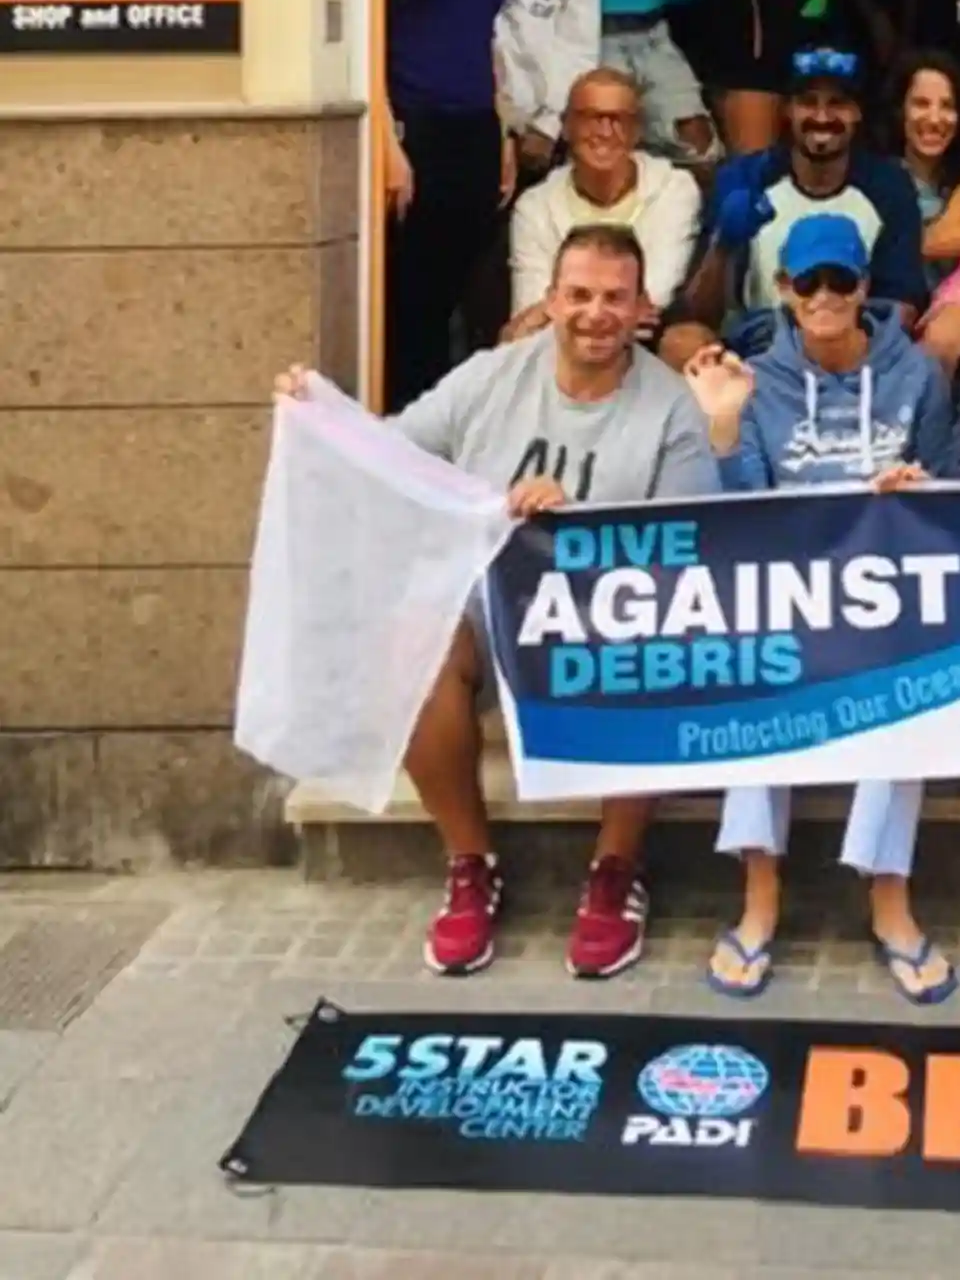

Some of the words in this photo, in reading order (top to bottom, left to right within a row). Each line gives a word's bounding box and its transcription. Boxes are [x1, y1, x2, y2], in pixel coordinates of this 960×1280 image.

[13, 5, 73, 29] SHOP
[80, 5, 120, 29] and
[126, 4, 204, 28] OFFICE
[554, 521, 699, 571] DIVE
[550, 635, 803, 697] DEBRIS
[677, 711, 829, 758] Protecting
[835, 690, 890, 727] Our
[398, 1078, 601, 1103] INSTRUCTOR
[354, 1095, 594, 1120] DEVELOPMENT
[458, 1119, 587, 1141] CENTER
[621, 1115, 755, 1148] PADI
